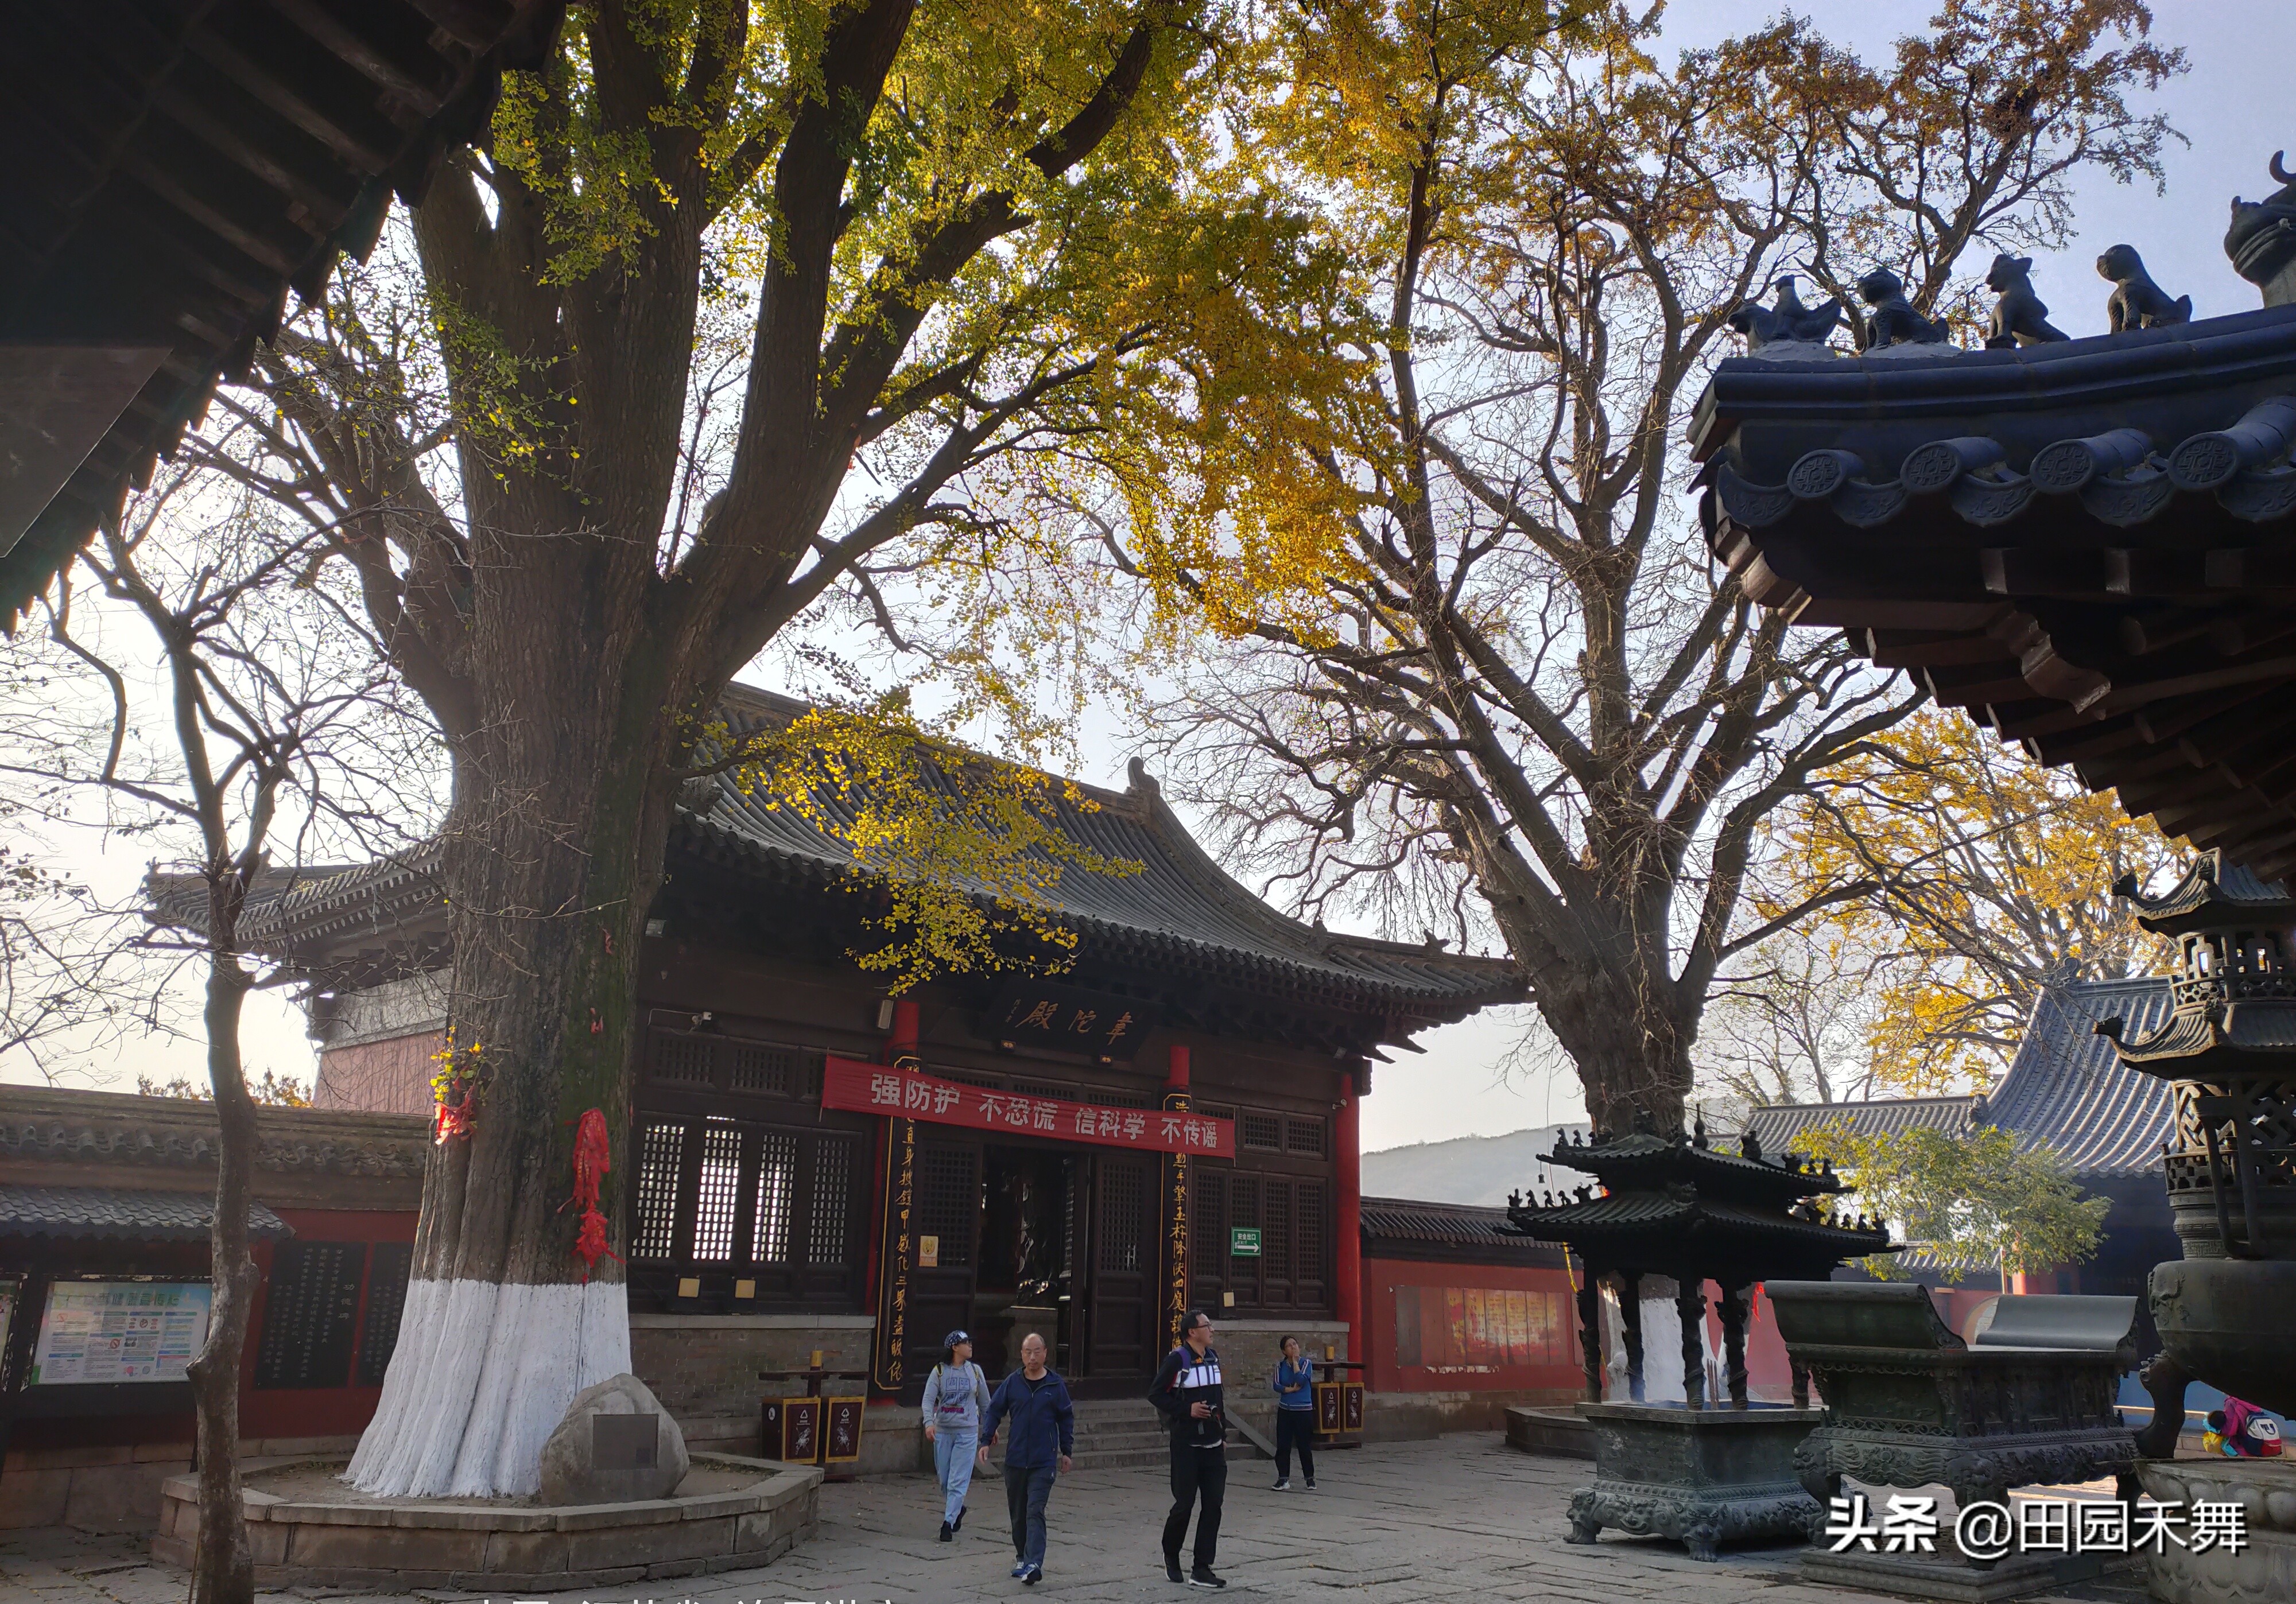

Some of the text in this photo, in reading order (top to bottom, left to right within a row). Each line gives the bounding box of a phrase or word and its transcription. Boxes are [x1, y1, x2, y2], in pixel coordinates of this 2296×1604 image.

[871, 1072, 1218, 1149] 强防护 不恐慌 信科学 不传谣
